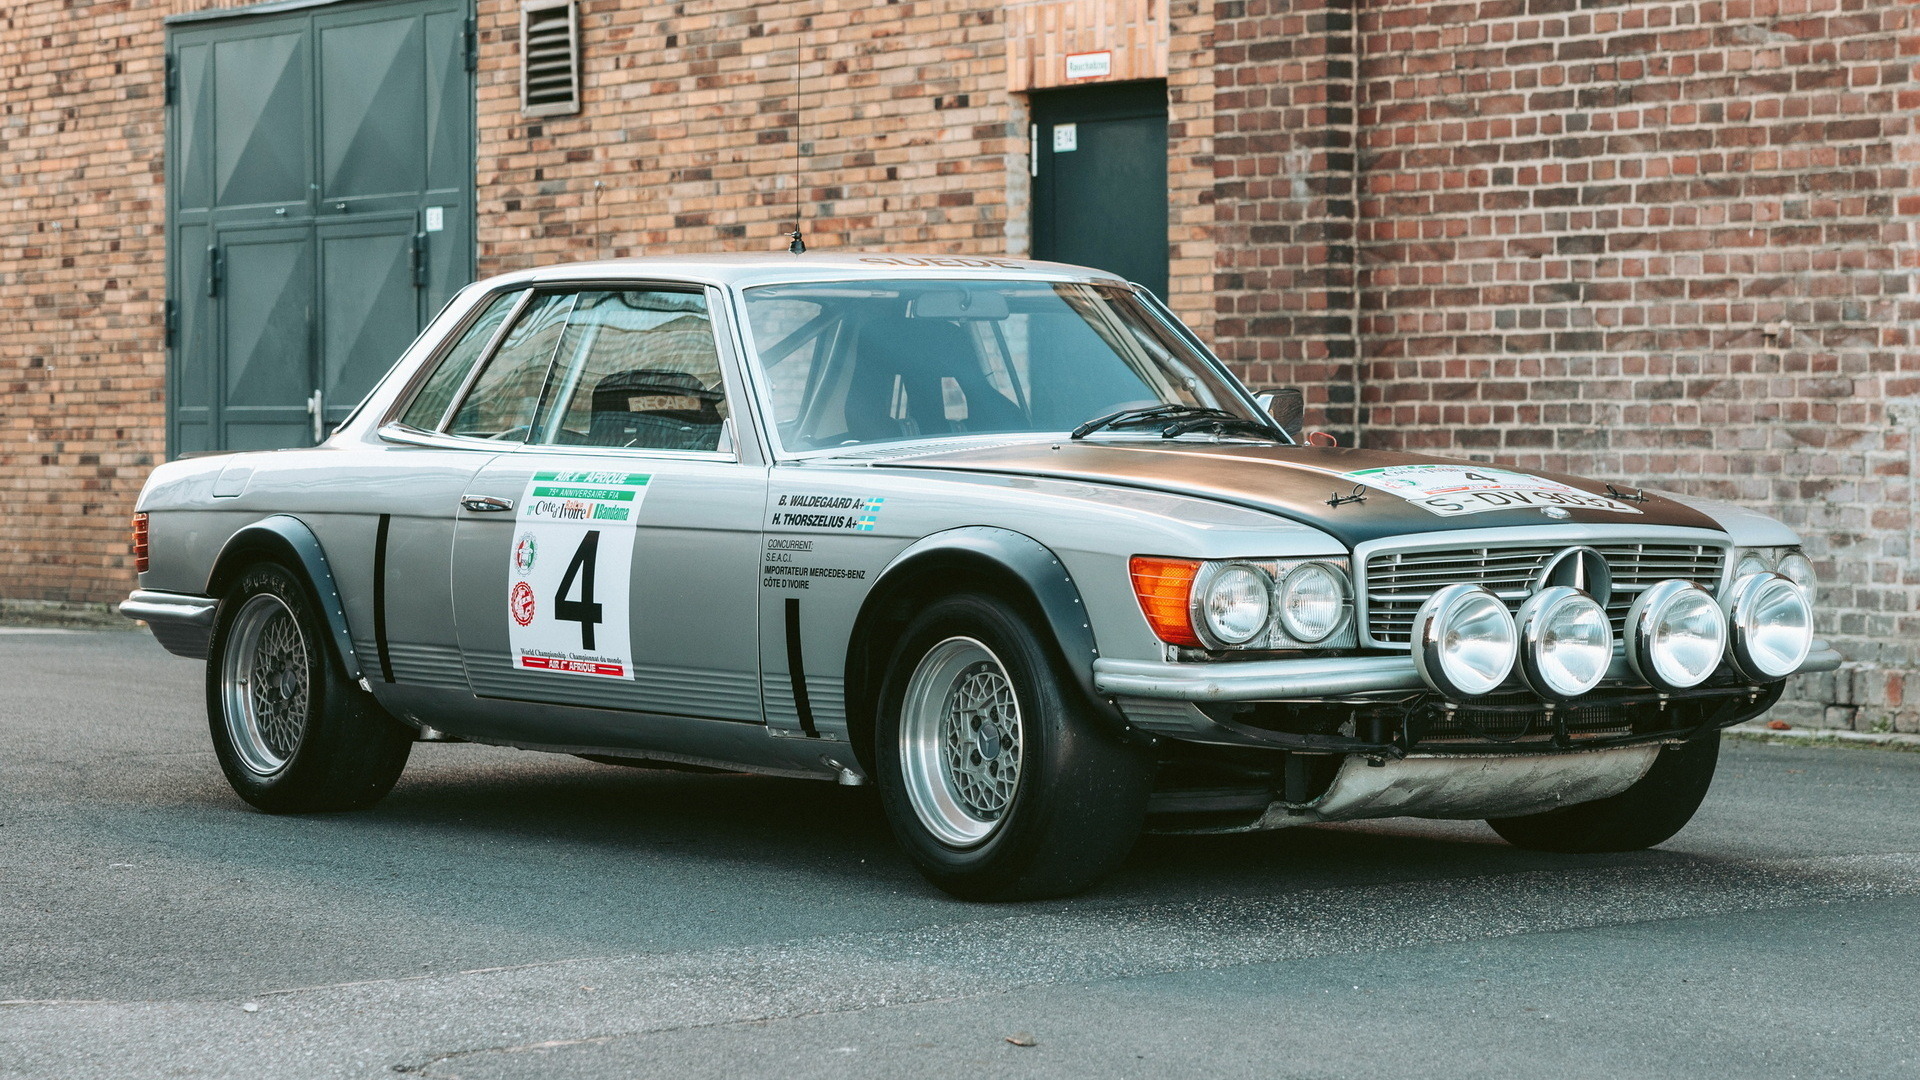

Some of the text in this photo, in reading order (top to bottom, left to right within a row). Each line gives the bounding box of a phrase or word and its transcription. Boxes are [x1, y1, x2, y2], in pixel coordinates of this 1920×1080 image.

[858, 257, 1026, 270] SUEDE
[633, 396, 700, 410] RECARO
[584, 472, 629, 484] AFRIQUE
[1464, 472, 1498, 483] 4
[559, 489, 606, 498] ANNIVERSAIRE
[607, 491, 619, 499] FIA
[778, 495, 787, 506] B.
[790, 495, 852, 509] WALDEGAARD
[598, 503, 630, 521] Bandama
[772, 513, 782, 525] H.
[783, 513, 845, 528] THORSZELIUS
[767, 539, 814, 549] CONCURRENT:
[764, 565, 866, 579] IMPORTATEUR MERCEDES-BENZ
[763, 576, 781, 588] CÔTE
[554, 530, 603, 651] 4
[548, 660, 597, 673] AIR AFRIQUE
